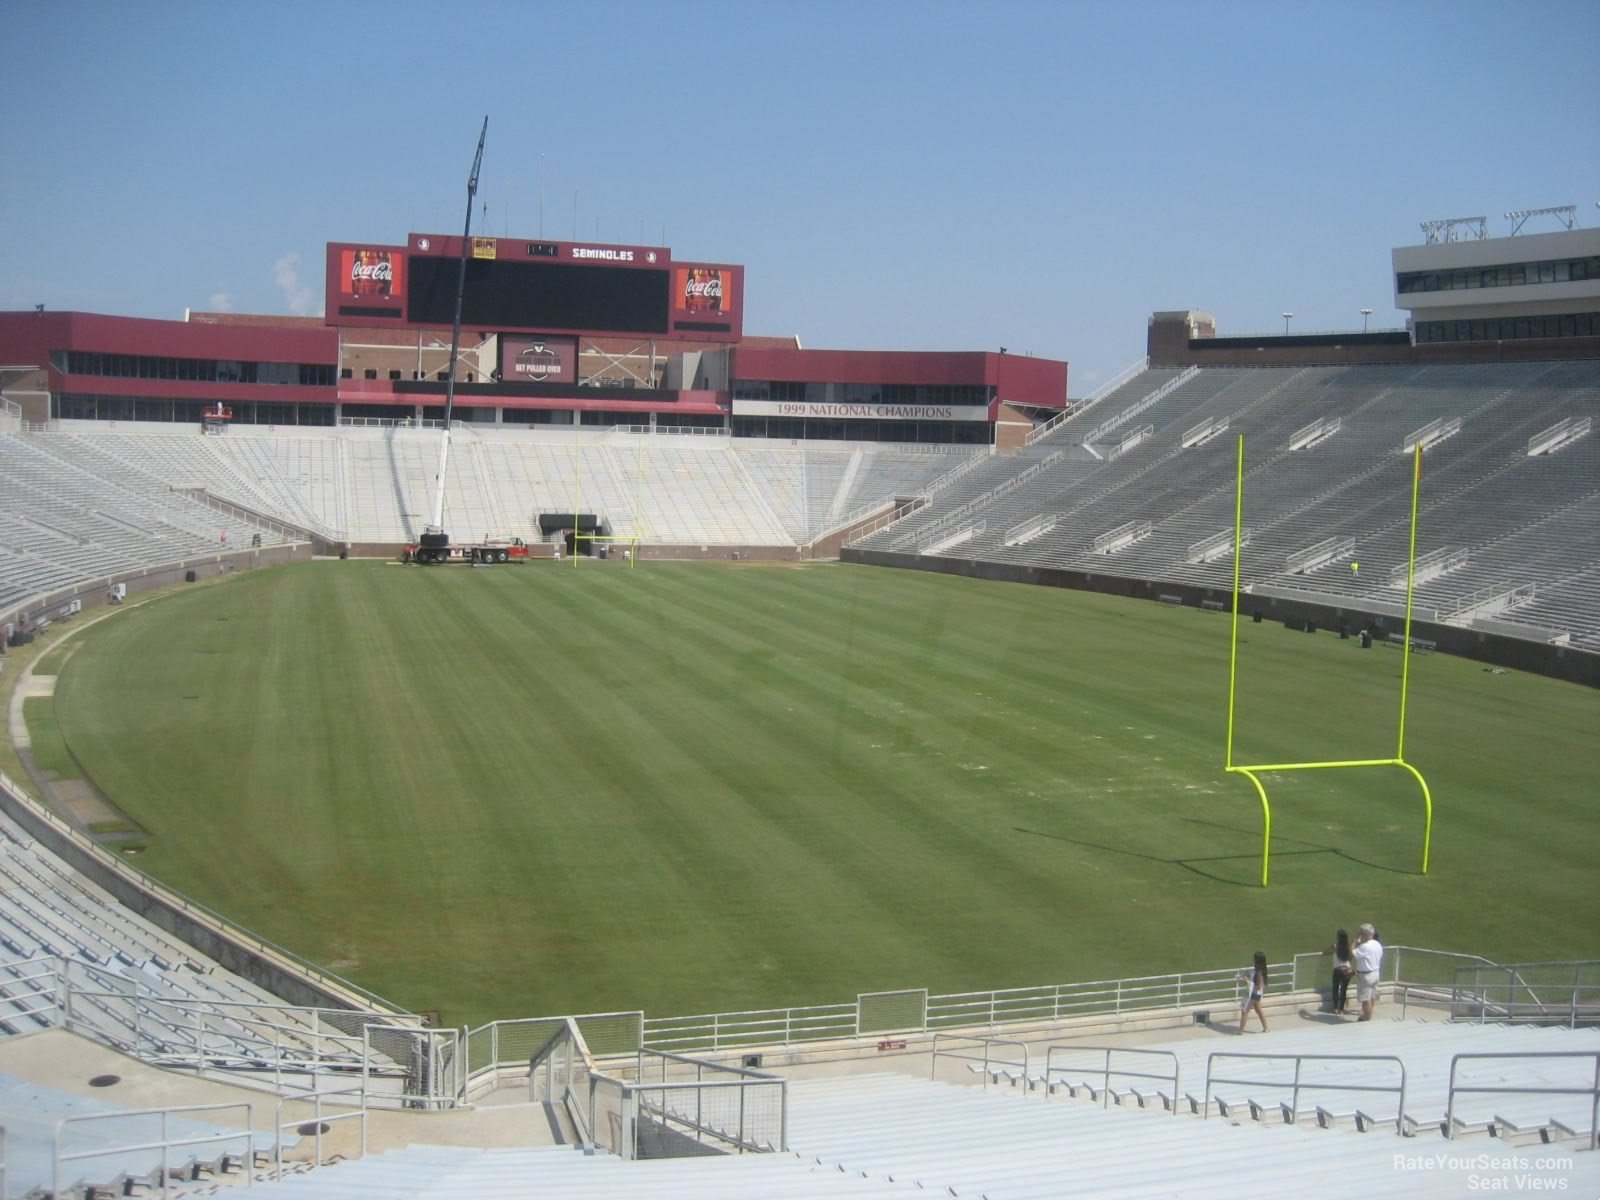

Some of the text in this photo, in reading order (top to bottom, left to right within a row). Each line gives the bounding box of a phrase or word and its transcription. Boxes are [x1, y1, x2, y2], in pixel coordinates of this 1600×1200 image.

[572, 248, 634, 261] SEMINOLES
[527, 364, 547, 373] PULLED
[547, 365, 561, 374] OVER
[777, 403, 952, 418] 1999 NATIONAL CHAMPIONS
